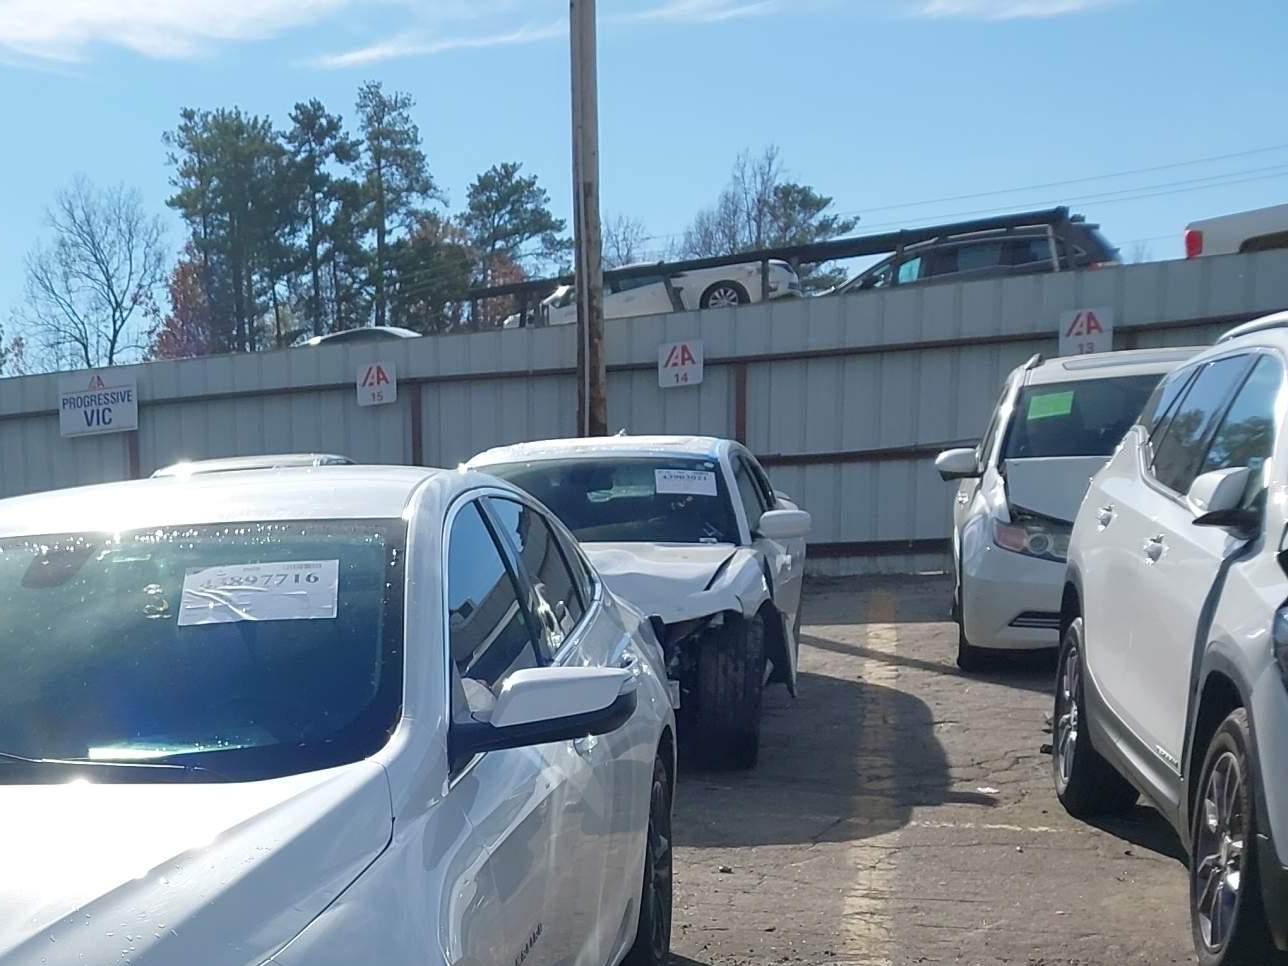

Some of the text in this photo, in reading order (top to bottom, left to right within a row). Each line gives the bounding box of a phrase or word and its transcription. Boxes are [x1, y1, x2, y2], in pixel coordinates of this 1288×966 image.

[674, 372, 688, 384] 14
[62, 389, 133, 410] PROGRESSIVE
[372, 391, 384, 402] 15
[84, 407, 113, 427] VIC
